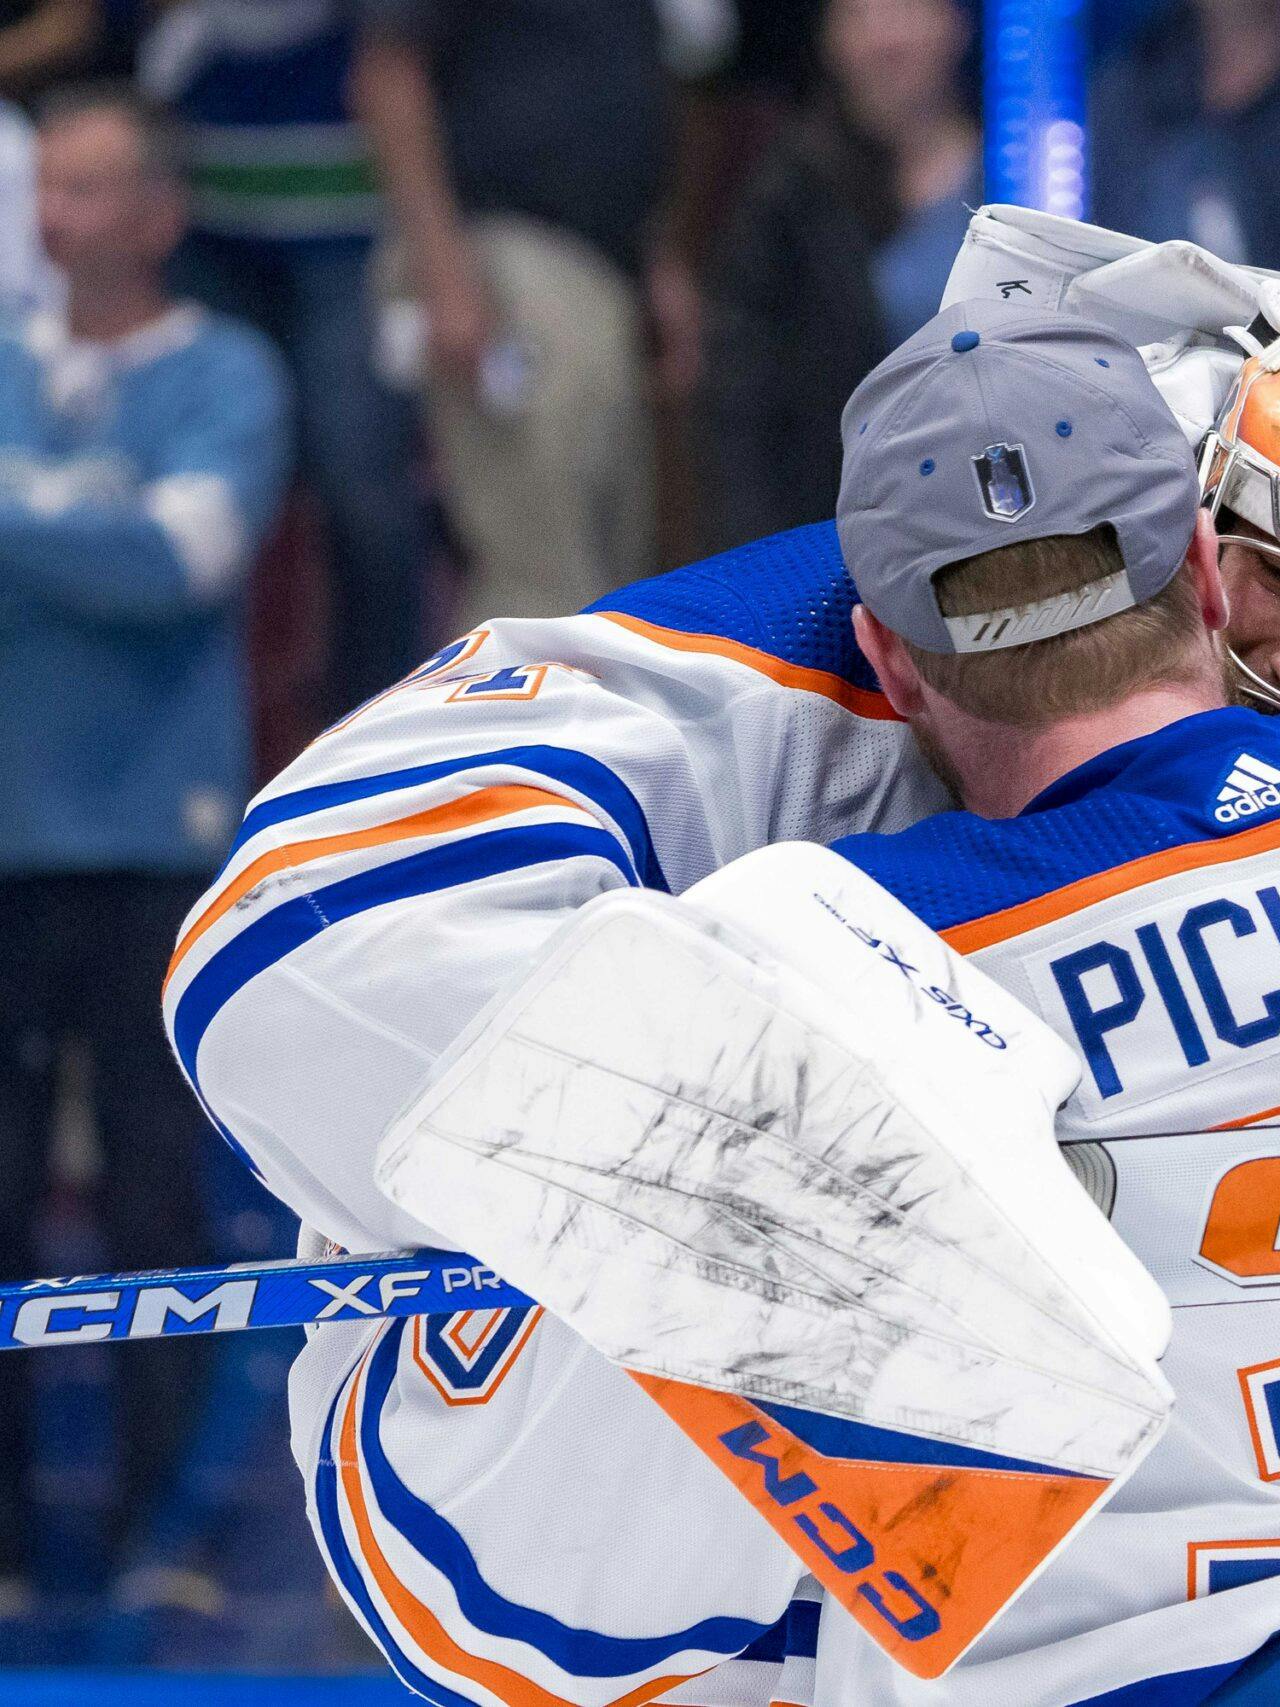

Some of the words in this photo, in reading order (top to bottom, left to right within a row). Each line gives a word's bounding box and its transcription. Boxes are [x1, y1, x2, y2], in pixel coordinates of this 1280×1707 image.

[0, 1279, 259, 1347] CM
[307, 1270, 431, 1319] XF
[441, 1265, 501, 1294] PR
[717, 1419, 942, 1642] CCM
